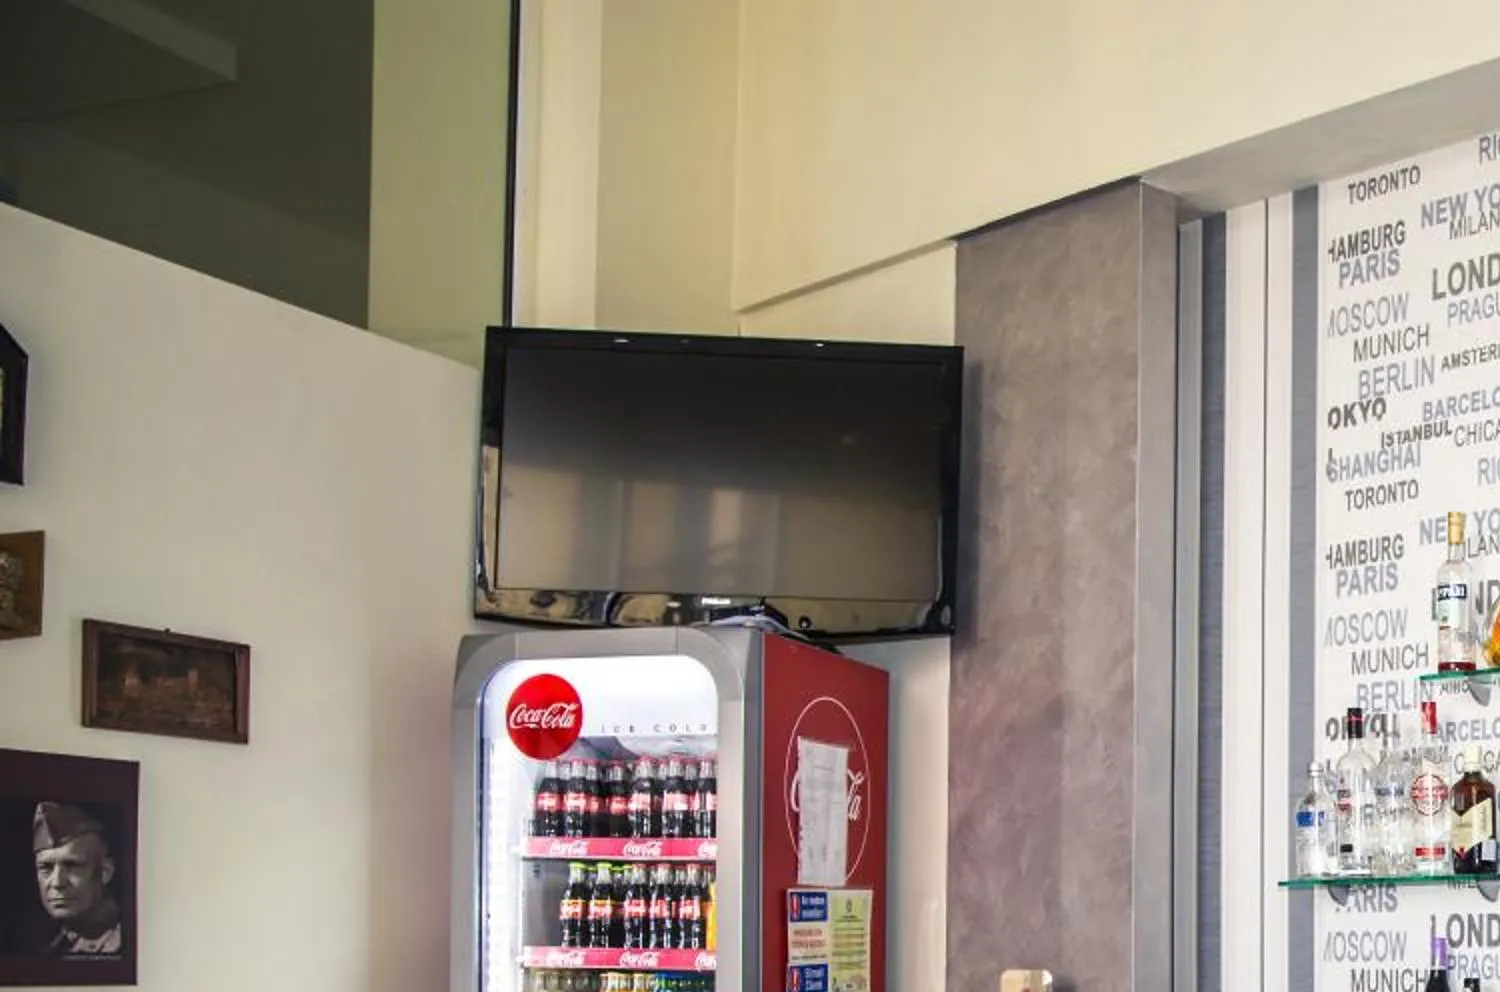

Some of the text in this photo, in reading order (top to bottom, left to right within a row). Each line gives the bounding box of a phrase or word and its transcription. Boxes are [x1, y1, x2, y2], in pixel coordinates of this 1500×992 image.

[1348, 165, 1421, 204] TORONTO
[1421, 200, 1468, 229] NEW
[1338, 251, 1400, 288] PARIS
[1353, 324, 1429, 362] MUNICH
[1359, 355, 1434, 400] BERLIN
[1381, 414, 1451, 449] ISTANBUL
[1326, 443, 1421, 483] SHANGHAI
[1345, 479, 1419, 511] TORONTO
[1336, 562, 1399, 597] PARIS
[1351, 643, 1429, 676] MUNICH
[1357, 681, 1434, 713] BERLIN
